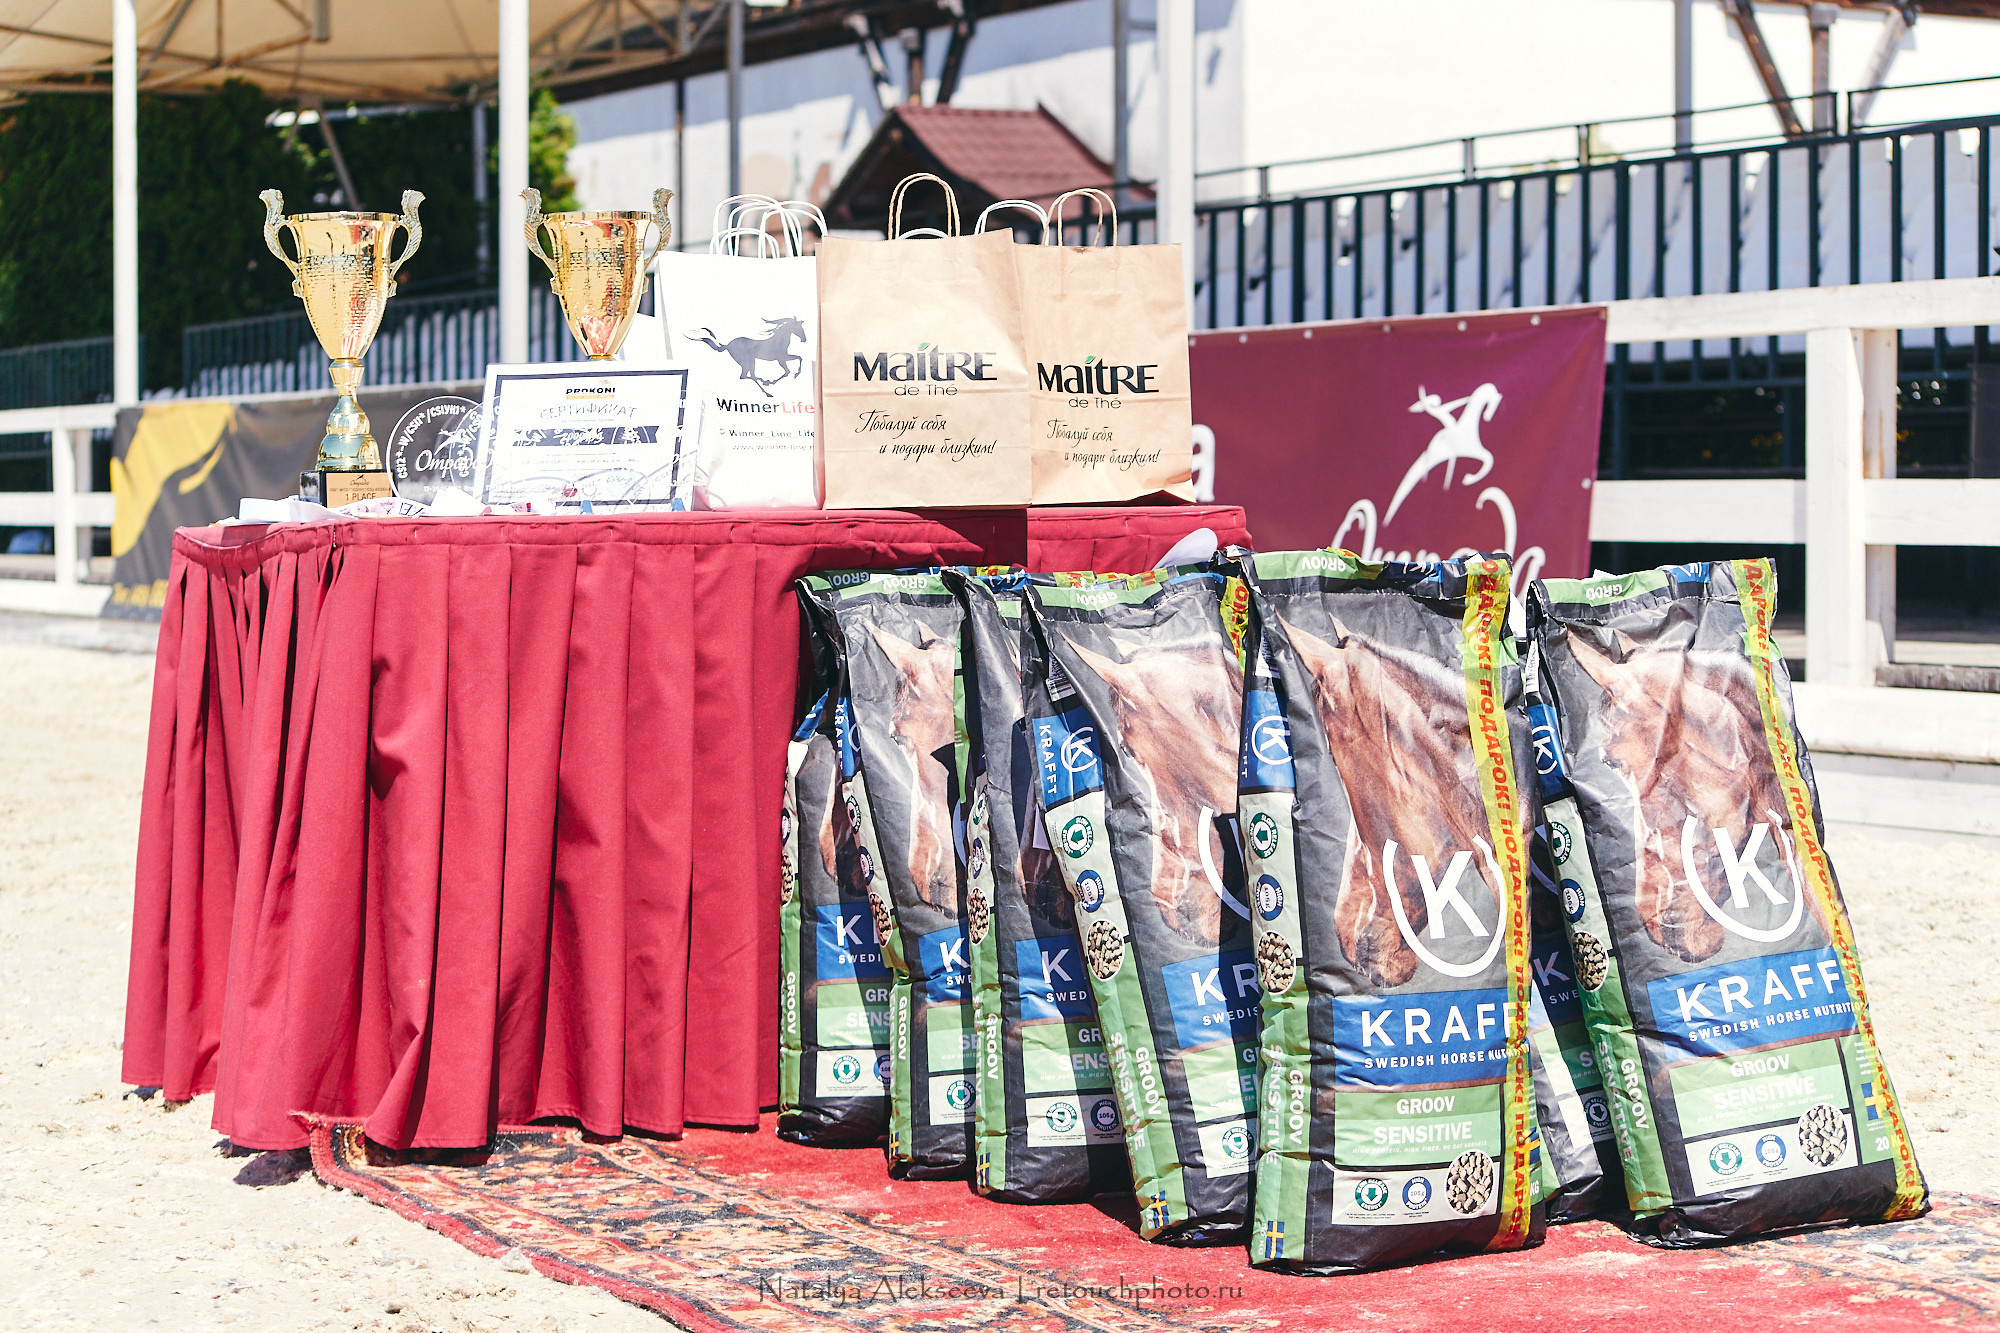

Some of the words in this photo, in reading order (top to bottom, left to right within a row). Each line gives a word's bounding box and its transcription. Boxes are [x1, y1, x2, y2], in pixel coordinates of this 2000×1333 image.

[894, 385, 920, 396] de
[926, 384, 958, 396] Thé
[1068, 397, 1089, 409] de
[1094, 397, 1122, 409] Thé
[855, 408, 919, 439] Побалуй
[920, 414, 947, 431] себя
[879, 444, 888, 454] и
[892, 444, 936, 463] подари
[940, 437, 998, 462] близким!
[1301, 555, 1347, 573] GROOV
[1477, 559, 1499, 671] ОДАРОК!
[1039, 724, 1058, 795] KRAFFT
[1478, 678, 1511, 811] ПОДАРОК!
[1500, 817, 1524, 958] ПОДАРОК!
[838, 953, 881, 965] SWEDI
[786, 971, 797, 1035] GROOV
[1046, 990, 1087, 1003] SWED
[1676, 959, 1841, 1023] KRAFF
[898, 995, 908, 1061] GROOV
[1202, 1006, 1258, 1027] SWEDIS
[1361, 1002, 1522, 1048] KRAFF
[1688, 1017, 1760, 1043] SWEDISH
[1766, 1008, 1811, 1027] HORSE
[1813, 1001, 1865, 1018] NUTRITIO
[986, 1013, 999, 1081] GROOV
[1364, 1055, 1435, 1069] SWEDISH
[1441, 1051, 1485, 1065] HORSE
[1729, 1053, 1791, 1079] GROOV
[1110, 1031, 1147, 1151] SENSITIVE
[1135, 1046, 1163, 1117] GROOV
[1620, 1058, 1651, 1130] GROOV
[1713, 1074, 1817, 1112] SENSITIVE
[1289, 1069, 1305, 1145] GROOV
[1396, 1095, 1456, 1115] GROOV
[1373, 1121, 1473, 1145] SENSITIVE
[1875, 1135, 1890, 1153] 20
